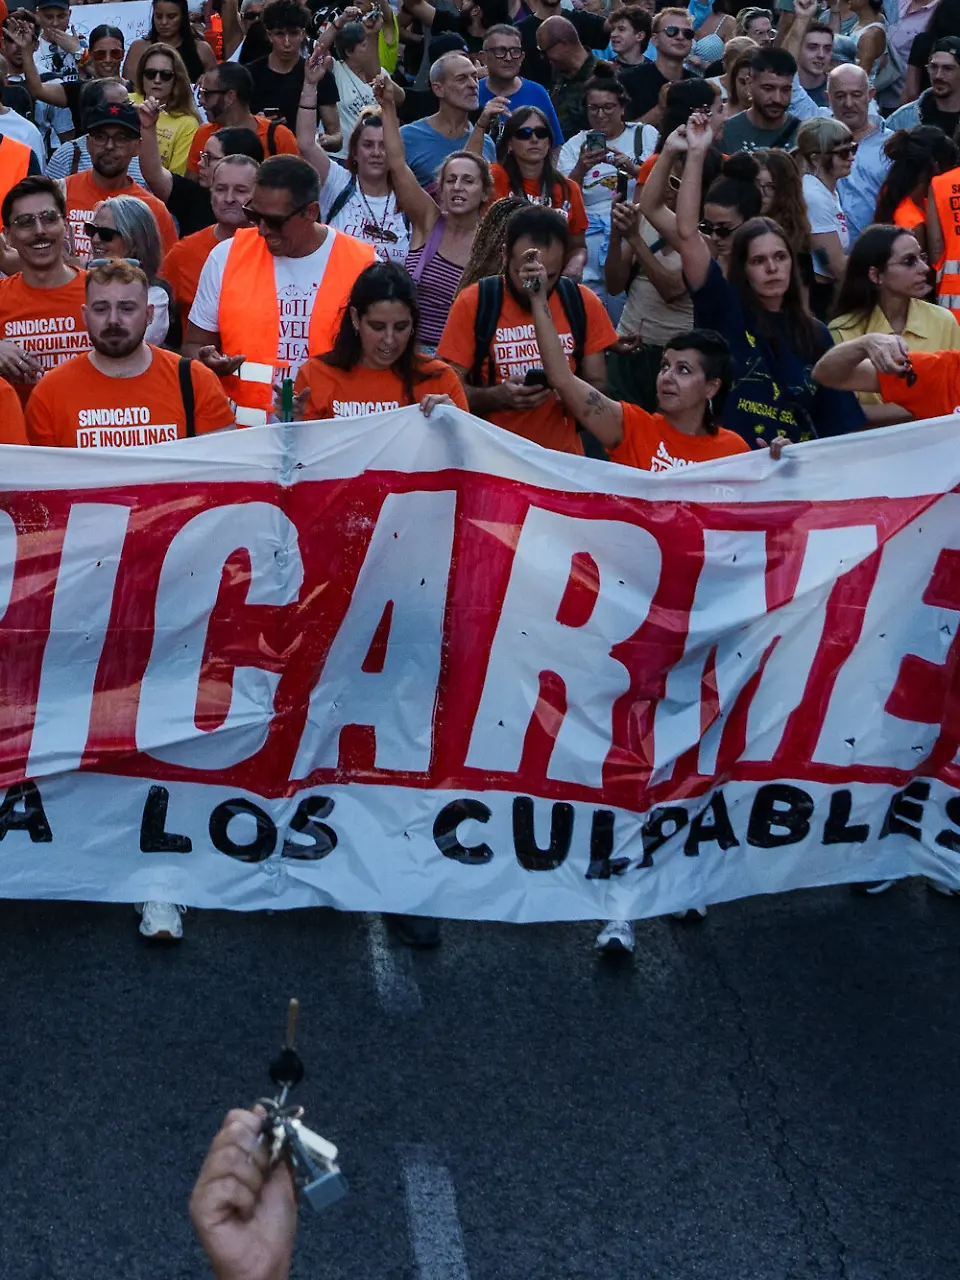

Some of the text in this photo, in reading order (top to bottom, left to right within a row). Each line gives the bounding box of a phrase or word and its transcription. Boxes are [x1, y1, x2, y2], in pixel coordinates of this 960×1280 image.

[4, 316, 76, 337] SINDICATO
[497, 347, 514, 360] DE
[78, 406, 151, 427] SINDICATO
[332, 400, 399, 418] SINDICATO
[80, 427, 176, 449] DE INQUILINAS
[139, 784, 339, 862] LOS
